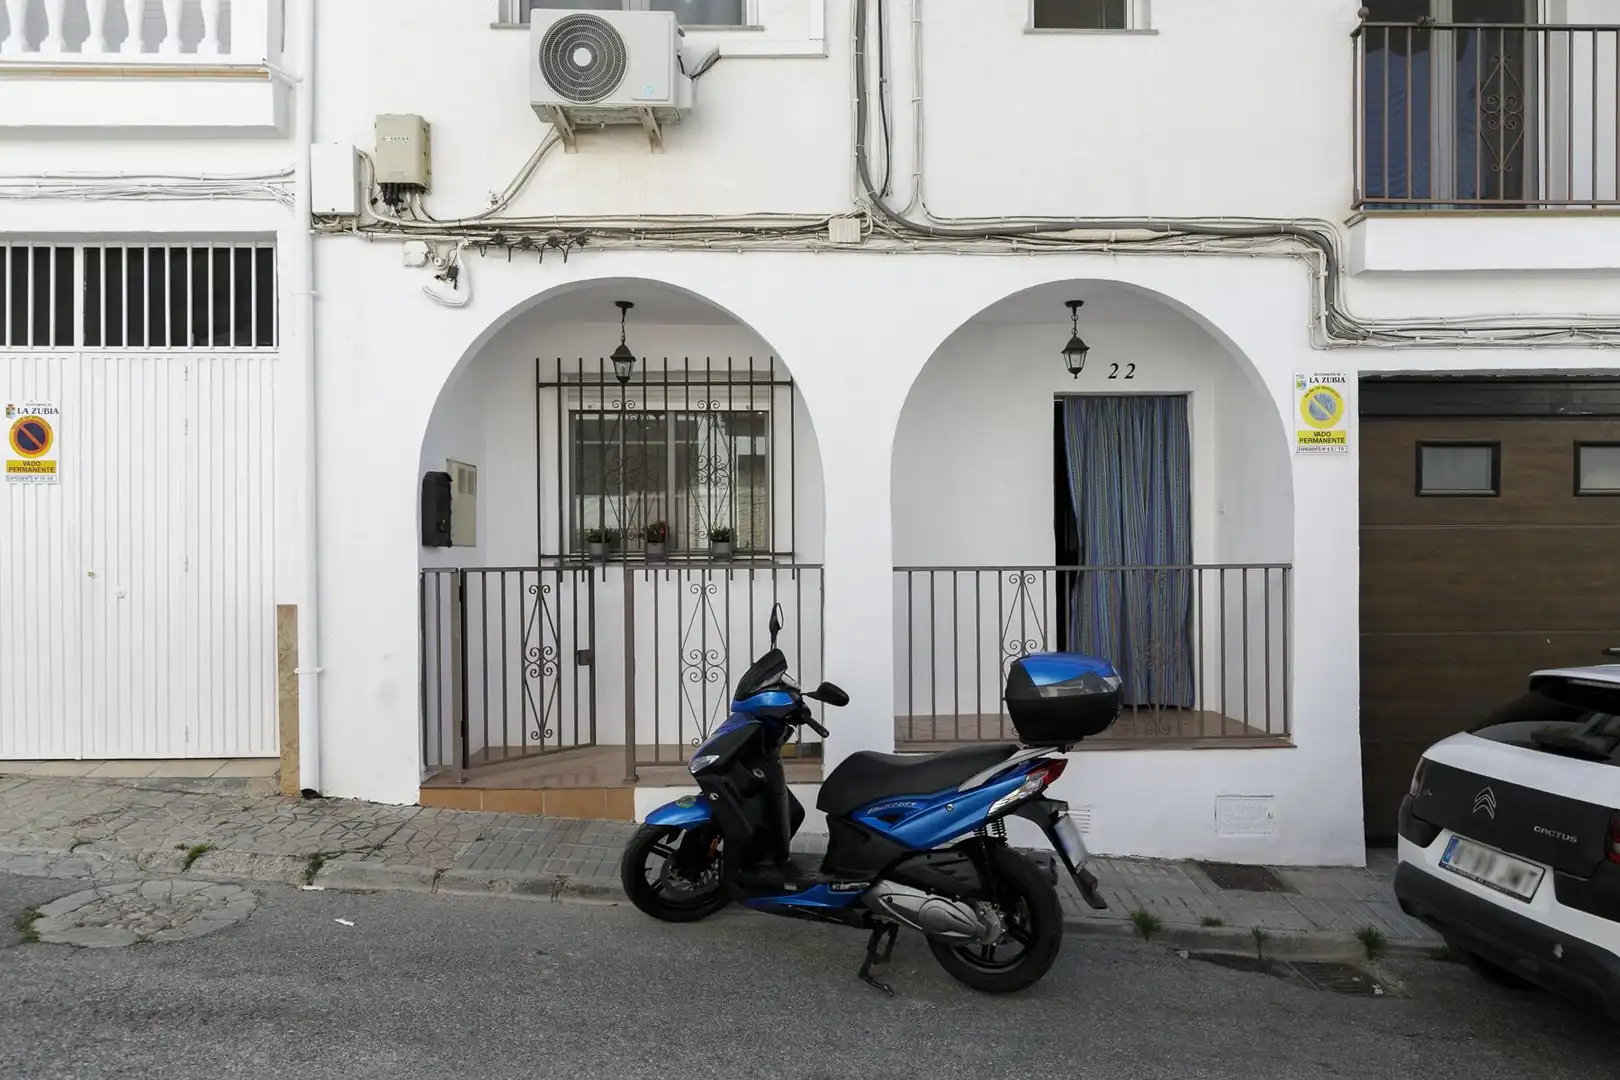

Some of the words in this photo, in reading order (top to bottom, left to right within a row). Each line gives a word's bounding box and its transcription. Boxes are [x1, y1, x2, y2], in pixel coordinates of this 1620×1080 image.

[1107, 362, 1136, 379] 22
[17, 407, 29, 415] LA
[31, 407, 59, 415] ZUBIA
[1533, 825, 1578, 843] CACTUS
